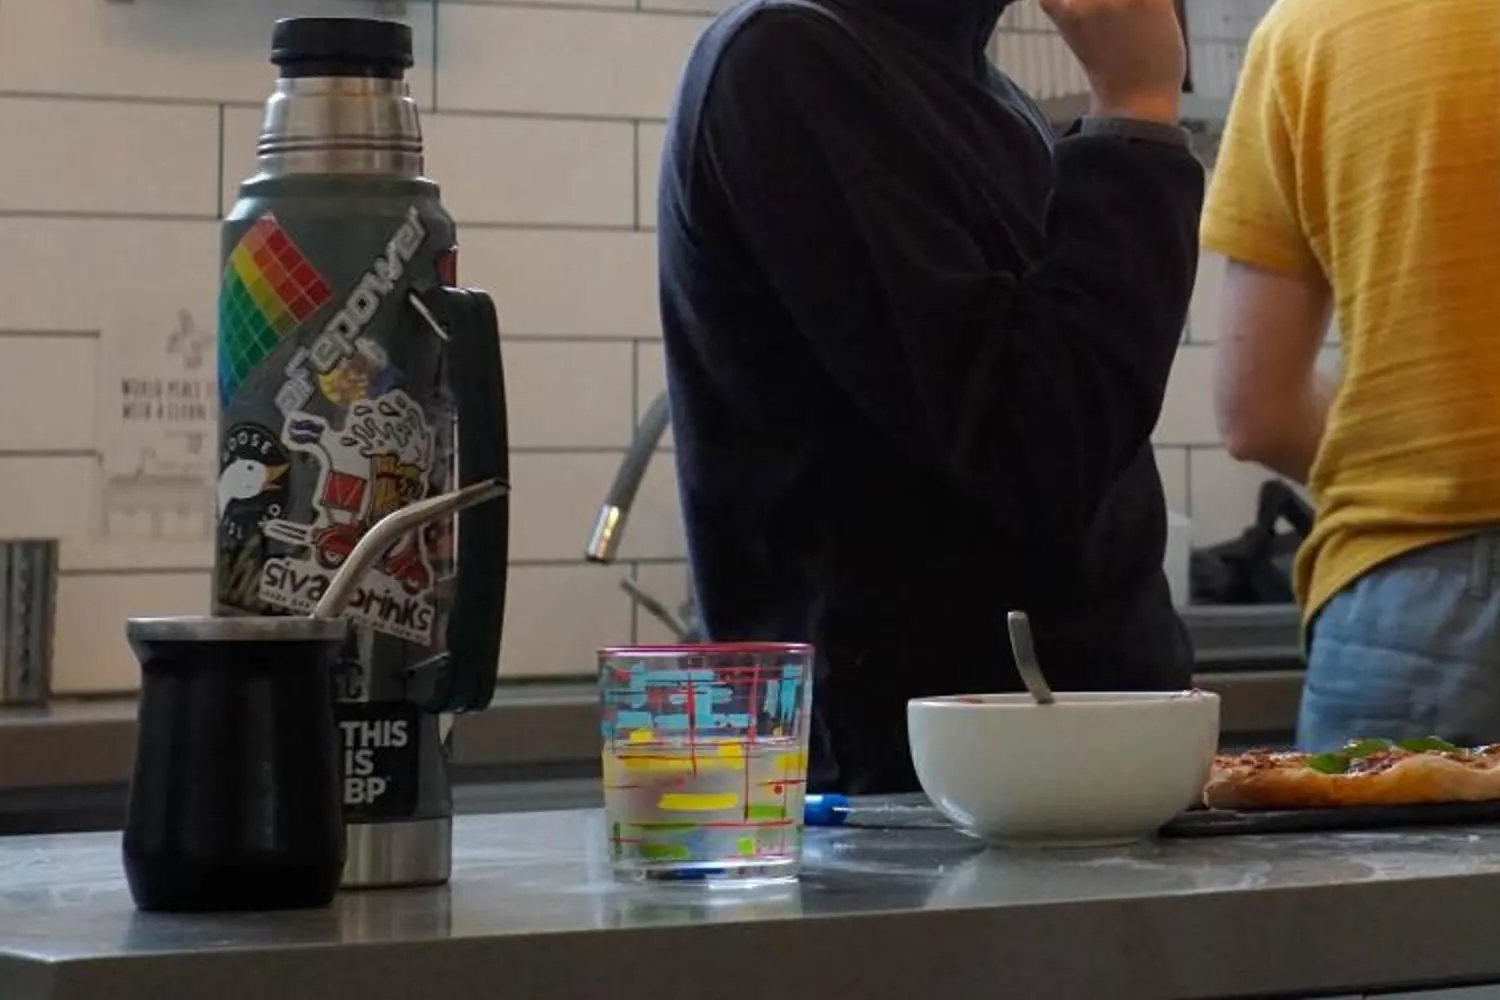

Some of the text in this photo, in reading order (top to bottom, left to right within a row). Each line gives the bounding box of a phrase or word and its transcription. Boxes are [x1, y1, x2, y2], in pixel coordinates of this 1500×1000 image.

[339, 720, 408, 747] THIS
[345, 750, 375, 776] IS
[343, 776, 387, 804] BP
